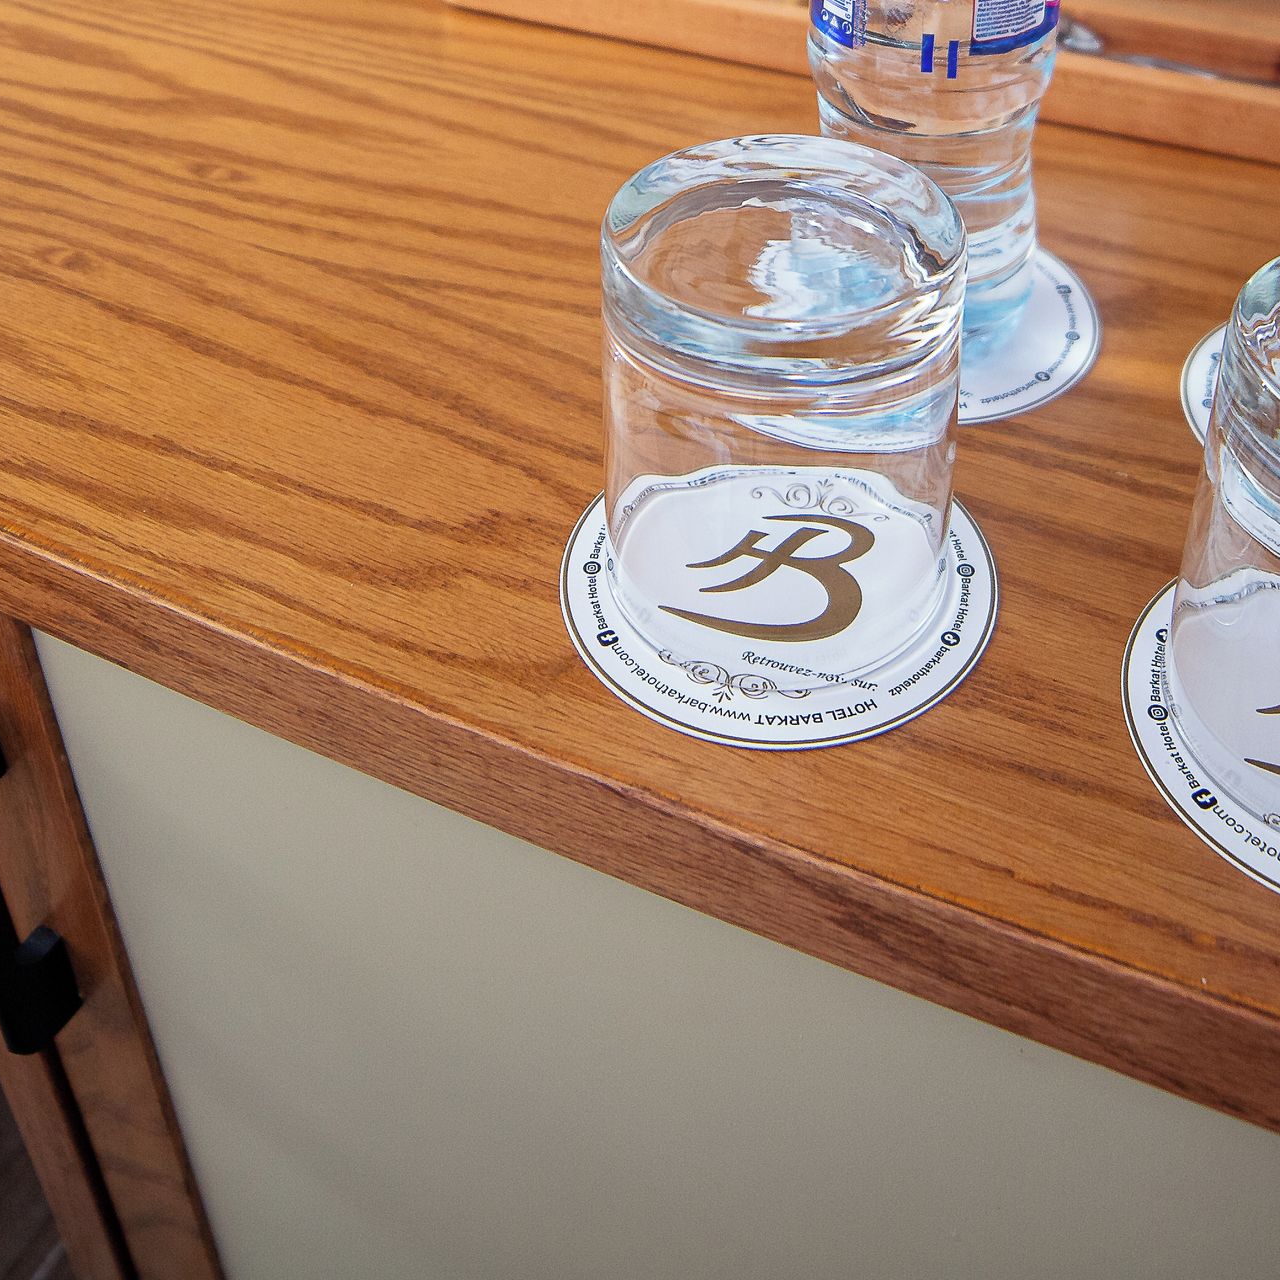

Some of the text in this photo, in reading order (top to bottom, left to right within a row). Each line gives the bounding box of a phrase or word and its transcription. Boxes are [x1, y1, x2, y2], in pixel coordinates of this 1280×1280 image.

[952, 539, 967, 561] Hotel
[959, 578, 971, 610] Barkat
[587, 531, 878, 725] HOTEL BARKAT www.barkathotel.com Barkat Hotel Barkat
[951, 610, 968, 632] Hotel
[888, 645, 950, 696] barkathoteldz
[1151, 642, 1166, 669] Hotel
[1150, 668, 1161, 702] Barkat
[1156, 722, 1176, 751] Hotel
[1170, 751, 1200, 789] Barkat
